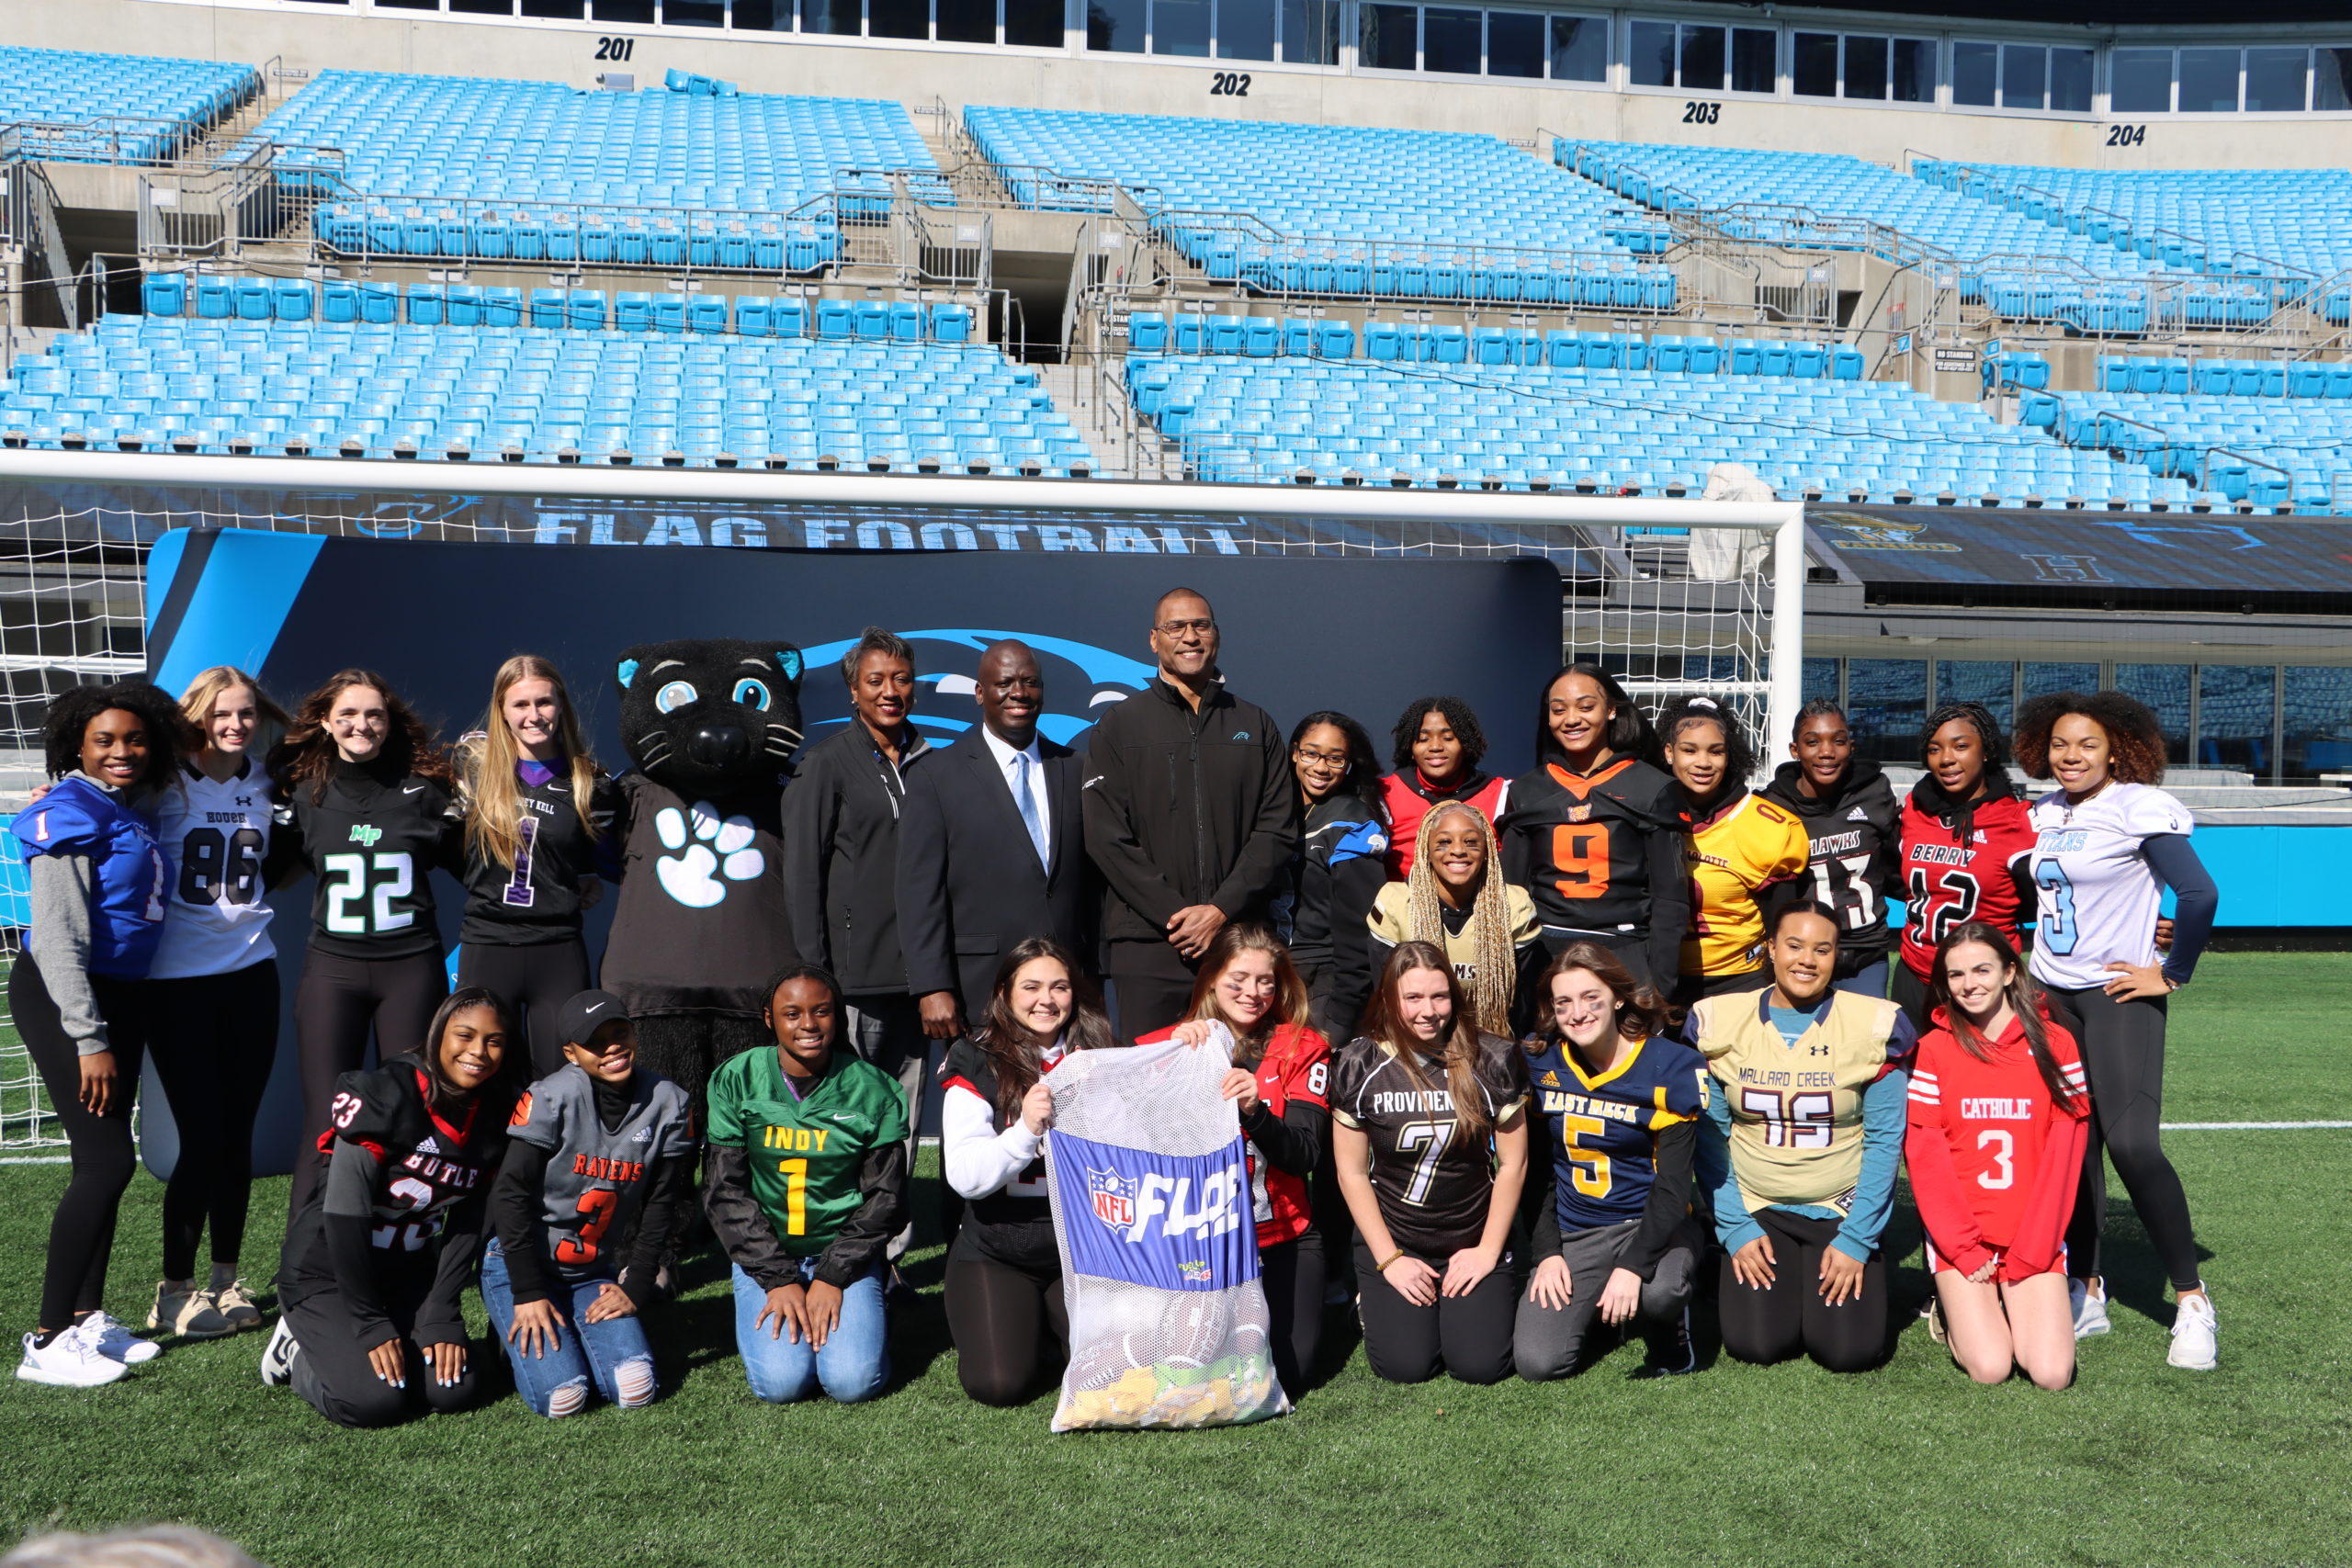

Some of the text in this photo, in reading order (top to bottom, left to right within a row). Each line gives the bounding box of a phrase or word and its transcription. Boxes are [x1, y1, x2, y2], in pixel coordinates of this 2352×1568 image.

[594, 37, 634, 62] 201
[1210, 72, 1251, 96] 202
[1682, 101, 1722, 125] 203
[2106, 124, 2146, 147] 204
[1946, 351, 1974, 359] STANDING
[533, 512, 768, 547] FLAG
[536, 800, 555, 815] KELL
[35, 811, 51, 842] 1
[178, 827, 266, 907] 86
[503, 815, 540, 908] 1
[1552, 822, 1610, 899] 9
[1909, 843, 1977, 867] BERRY
[143, 845, 167, 922] 1
[323, 851, 413, 934] 22
[1808, 850, 1878, 931] 13
[1905, 866, 1981, 948] 42
[2034, 857, 2080, 957] 3
[1452, 962, 1477, 980] MS
[1306, 1061, 1330, 1097] 8
[1540, 1078, 1561, 1088] adidas
[1695, 1067, 1711, 1111] 5
[1737, 1066, 1836, 1089] MALLARD CREEK
[332, 1091, 363, 1129] 23
[1374, 1089, 1455, 1114] PROVIDEN
[1543, 1090, 1640, 1123] EAST MECK
[1961, 1097, 2032, 1120] CATHOLIC
[416, 1145, 440, 1155] adidas
[763, 1125, 830, 1152] INDY
[1563, 1111, 1612, 1200] 5
[404, 1153, 479, 1190] BUTLE
[571, 1152, 646, 1183] RAVENS
[1395, 1118, 1459, 1207] 7
[1976, 1129, 2014, 1190] 3
[778, 1157, 808, 1236] 1
[1094, 1191, 1132, 1224] NFL
[553, 1187, 618, 1266] 3
